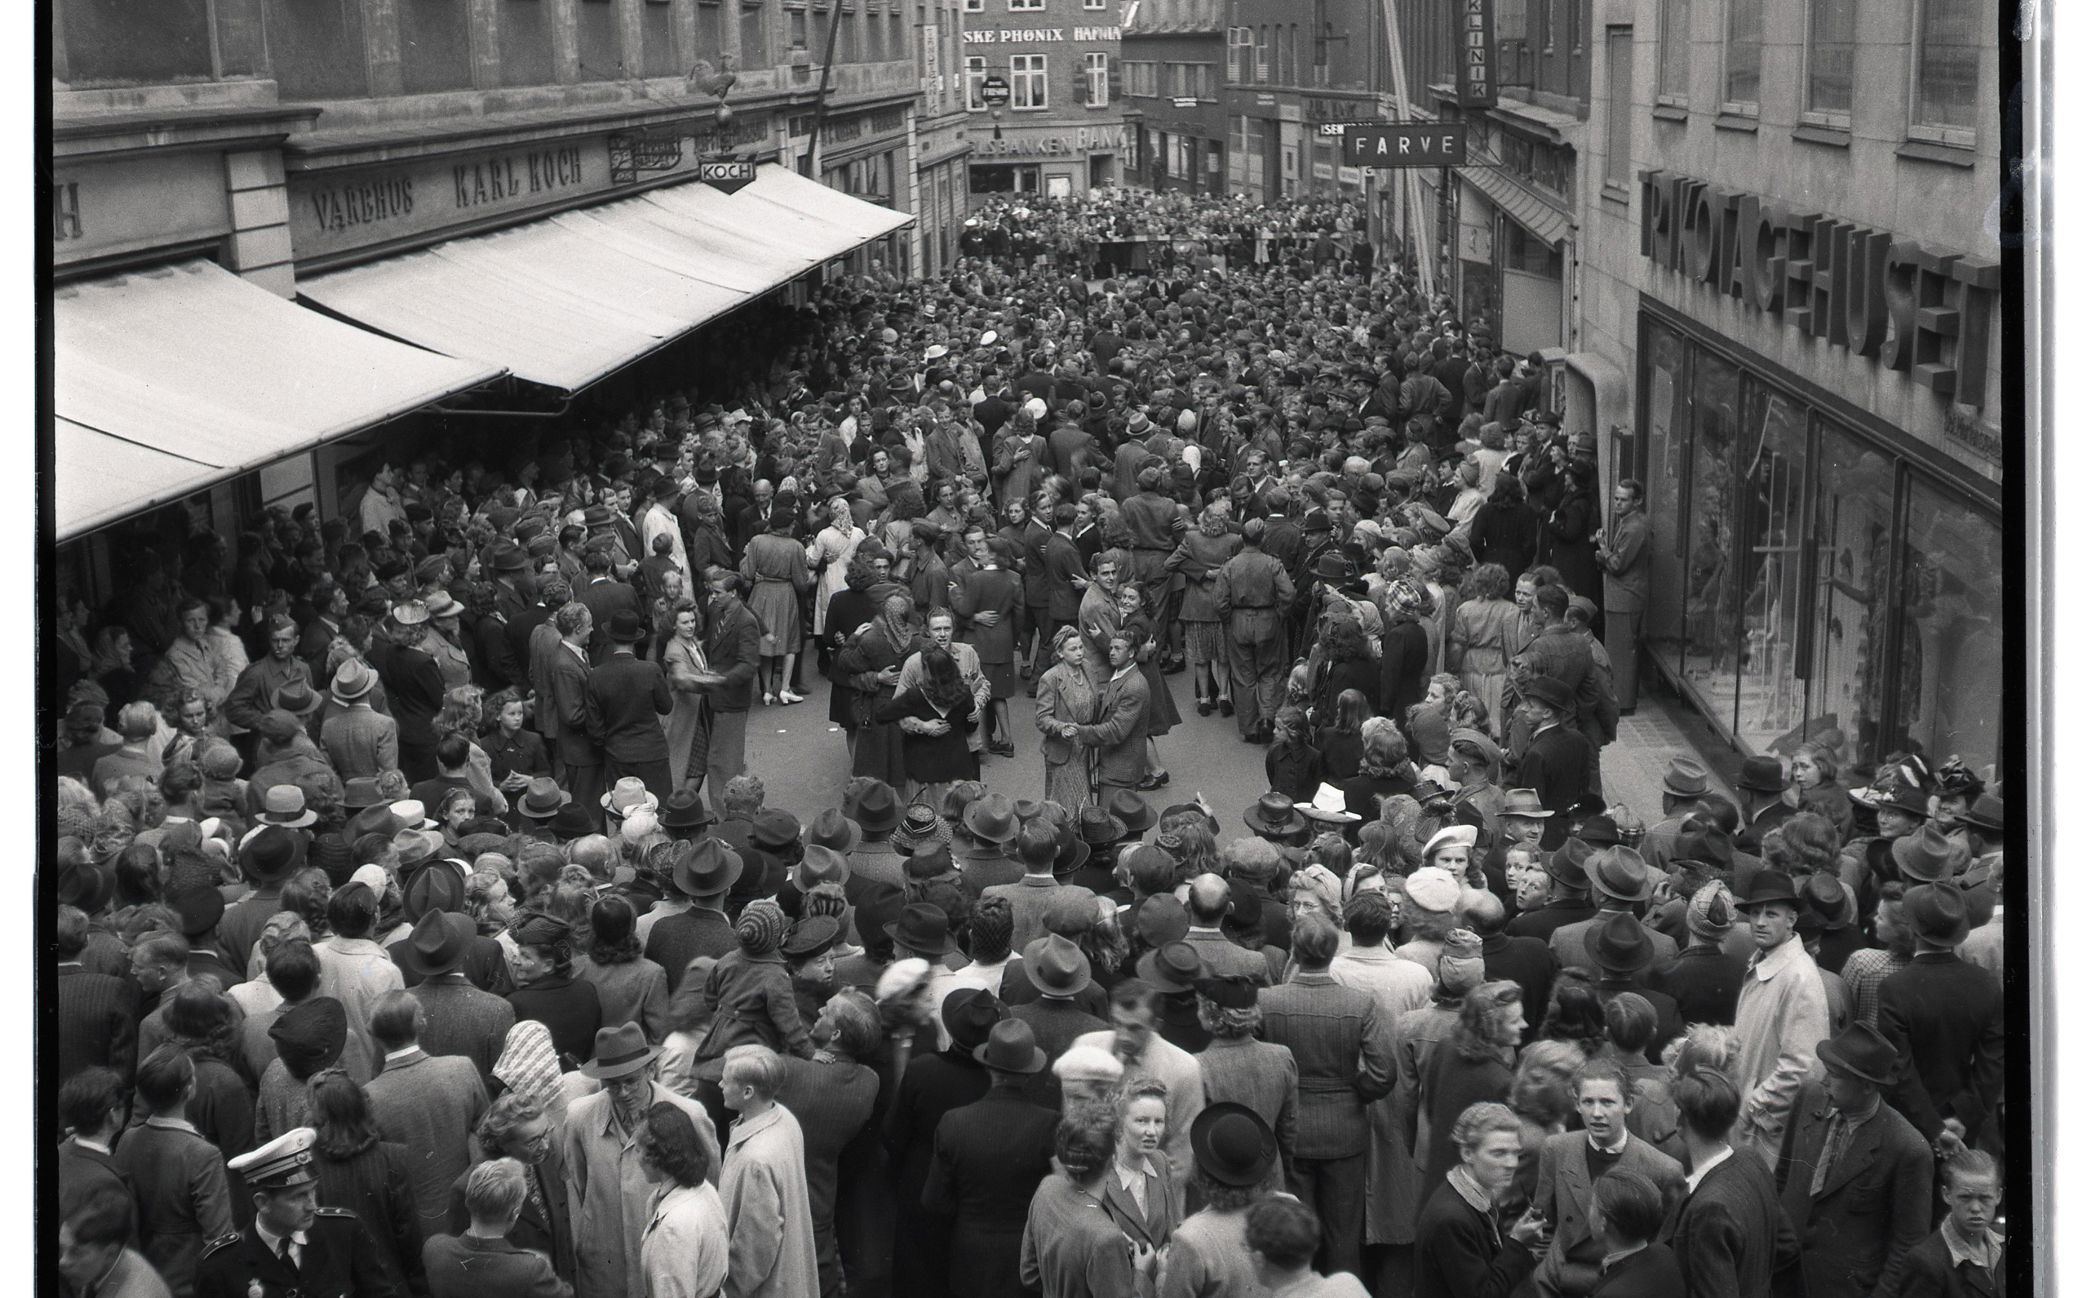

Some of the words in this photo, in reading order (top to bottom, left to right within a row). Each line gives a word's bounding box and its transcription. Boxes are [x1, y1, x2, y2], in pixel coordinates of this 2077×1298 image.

[963, 30, 995, 43] SKE
[1467, 0, 1485, 97] KLINIK
[1355, 136, 1454, 155] FARVE
[703, 164, 751, 179] KOCH
[312, 178, 413, 230] VAREHUS
[453, 157, 519, 208] KARL
[528, 146, 582, 193] KOCH
